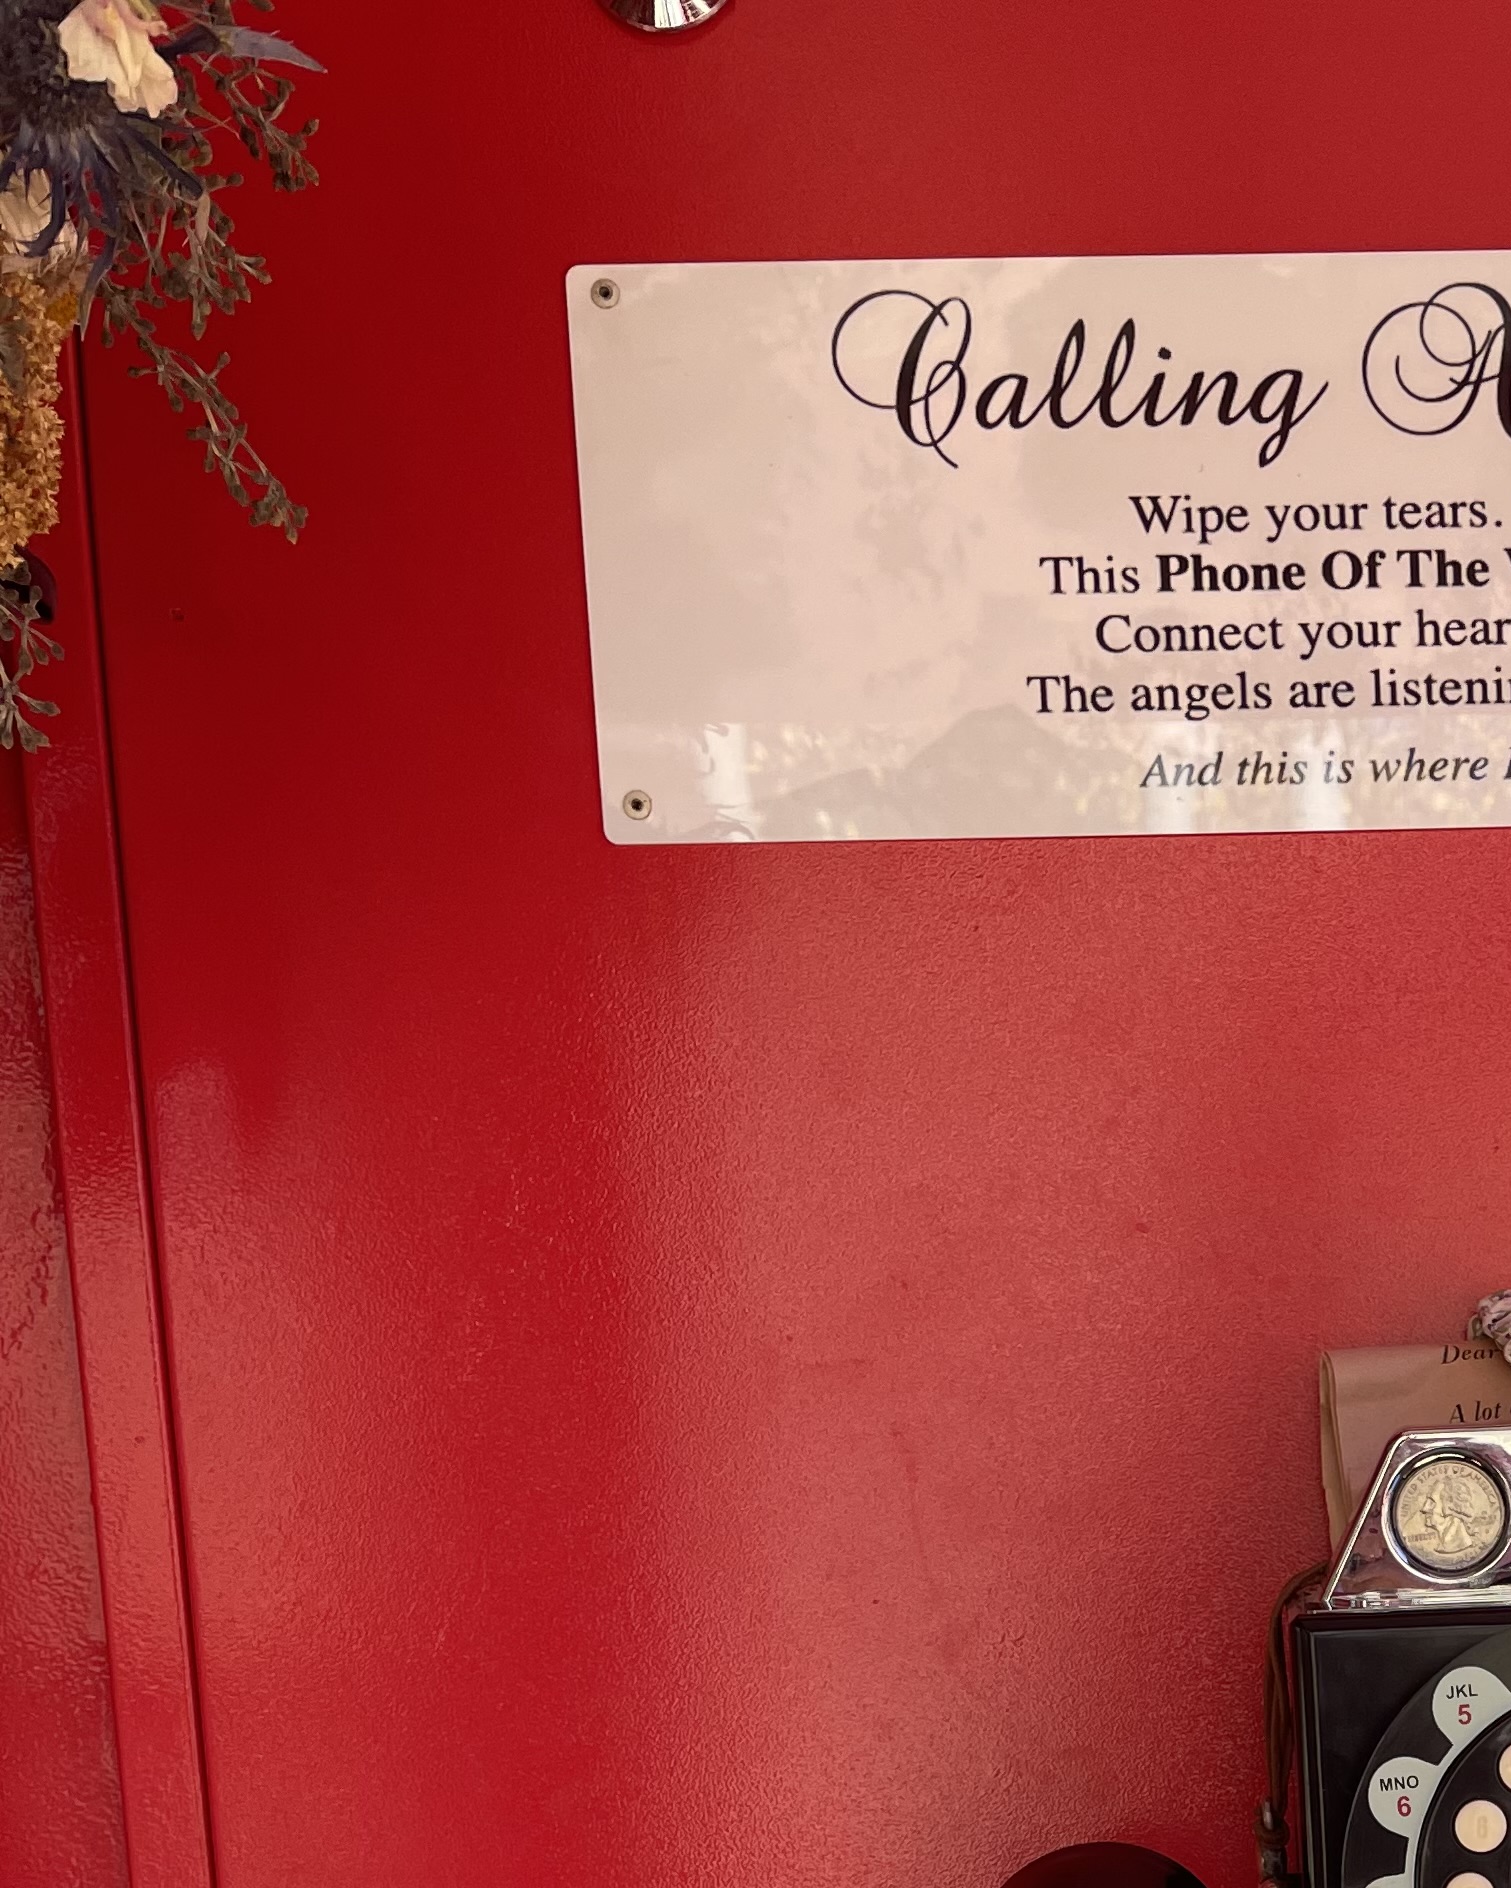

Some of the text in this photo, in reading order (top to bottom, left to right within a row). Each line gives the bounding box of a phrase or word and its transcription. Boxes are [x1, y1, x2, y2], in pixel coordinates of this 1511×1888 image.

[831, 289, 1329, 468] Calling
[1128, 494, 1250, 546] Wipe
[1264, 503, 1369, 544] your
[1382, 496, 1503, 530] tears.
[1039, 555, 1141, 595] This
[1154, 552, 1307, 593] Phone
[1320, 549, 1387, 591] Of
[1396, 548, 1491, 589] The
[1096, 614, 1286, 654] Connect
[1297, 621, 1402, 661] your
[1026, 674, 1116, 714] The
[1130, 670, 1272, 722] angels
[1288, 680, 1356, 709] are
[1139, 748, 1224, 788] And
[1237, 751, 1308, 786] this
[1324, 750, 1355, 784] is
[1368, 747, 1489, 783] where
[1450, 1403, 1465, 1424] A
[1475, 1401, 1501, 1422] lot
[1446, 1684, 1478, 1699] JKL
[1457, 1705, 1472, 1725] 5
[1379, 1775, 1419, 1791] MNO
[1397, 1797, 1412, 1817] 6
